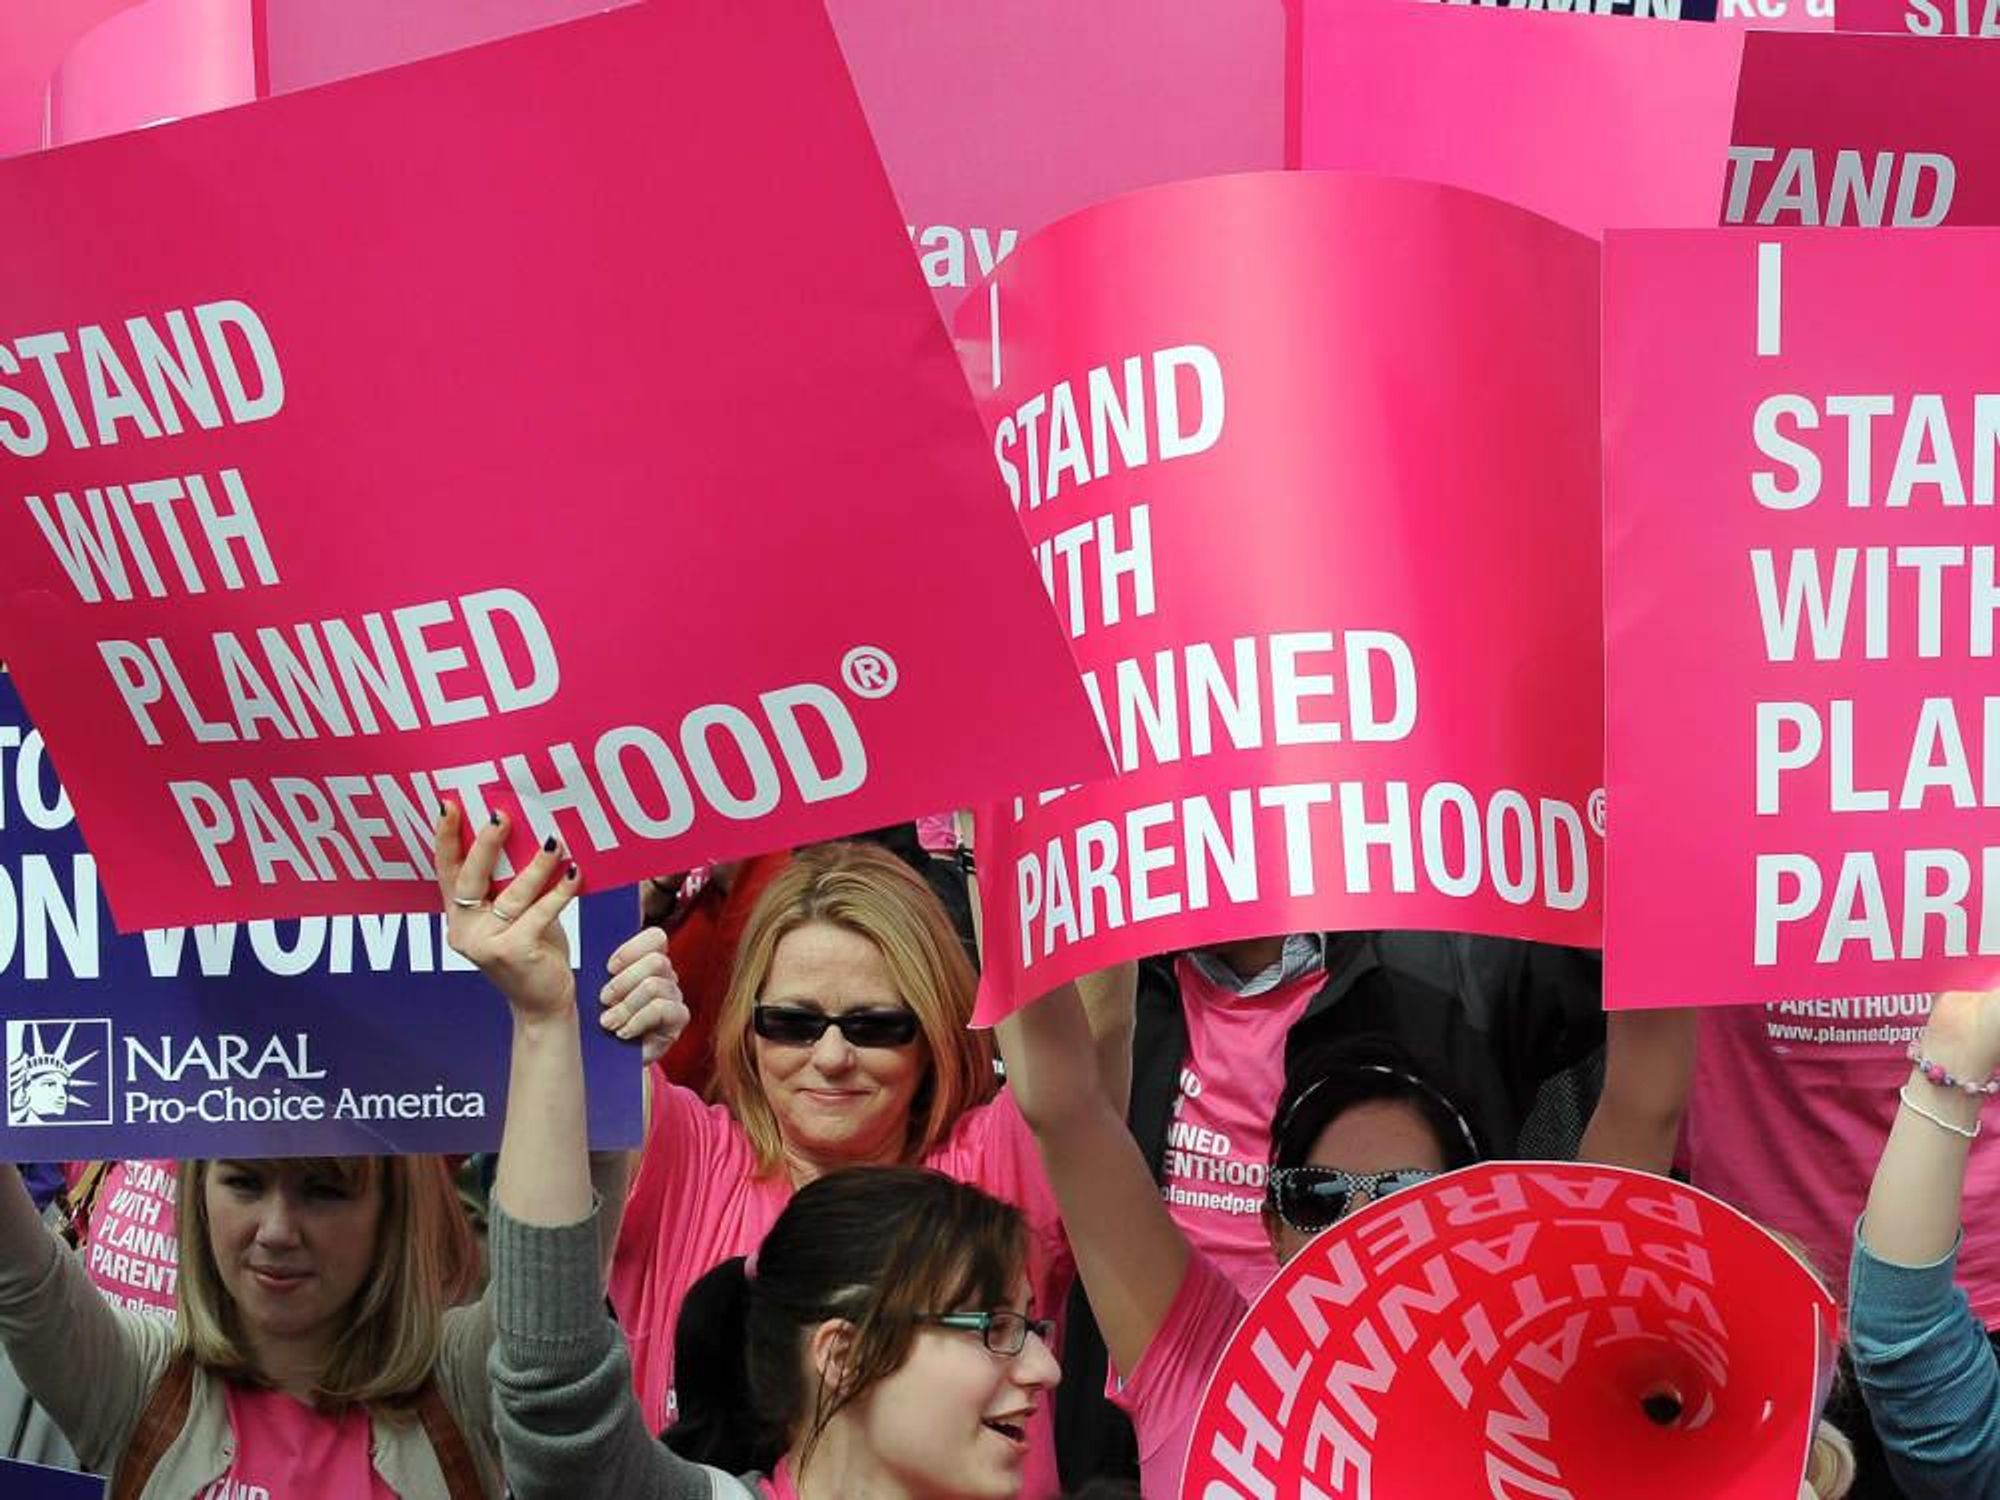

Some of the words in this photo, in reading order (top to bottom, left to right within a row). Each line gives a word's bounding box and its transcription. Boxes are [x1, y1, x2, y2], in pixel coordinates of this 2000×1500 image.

[1725, 146, 1957, 229] TAND
[906, 224, 1019, 288] ay
[1756, 242, 1782, 356] I
[0, 299, 286, 458] STAND
[993, 344, 1226, 513] STAND
[26, 469, 281, 604] WITH
[97, 587, 561, 746] PLANNED
[1015, 630, 1419, 823] NNED
[1755, 697, 2000, 815] PLA
[0, 854, 100, 980] N
[124, 1033, 327, 1082] NARAL
[124, 1086, 324, 1124] Pro-Choice
[333, 1085, 487, 1120] America
[108, 1188, 161, 1225] WITH
[1300, 1220, 1715, 1500] PLANNE
[1428, 1264, 1730, 1410] WITH
